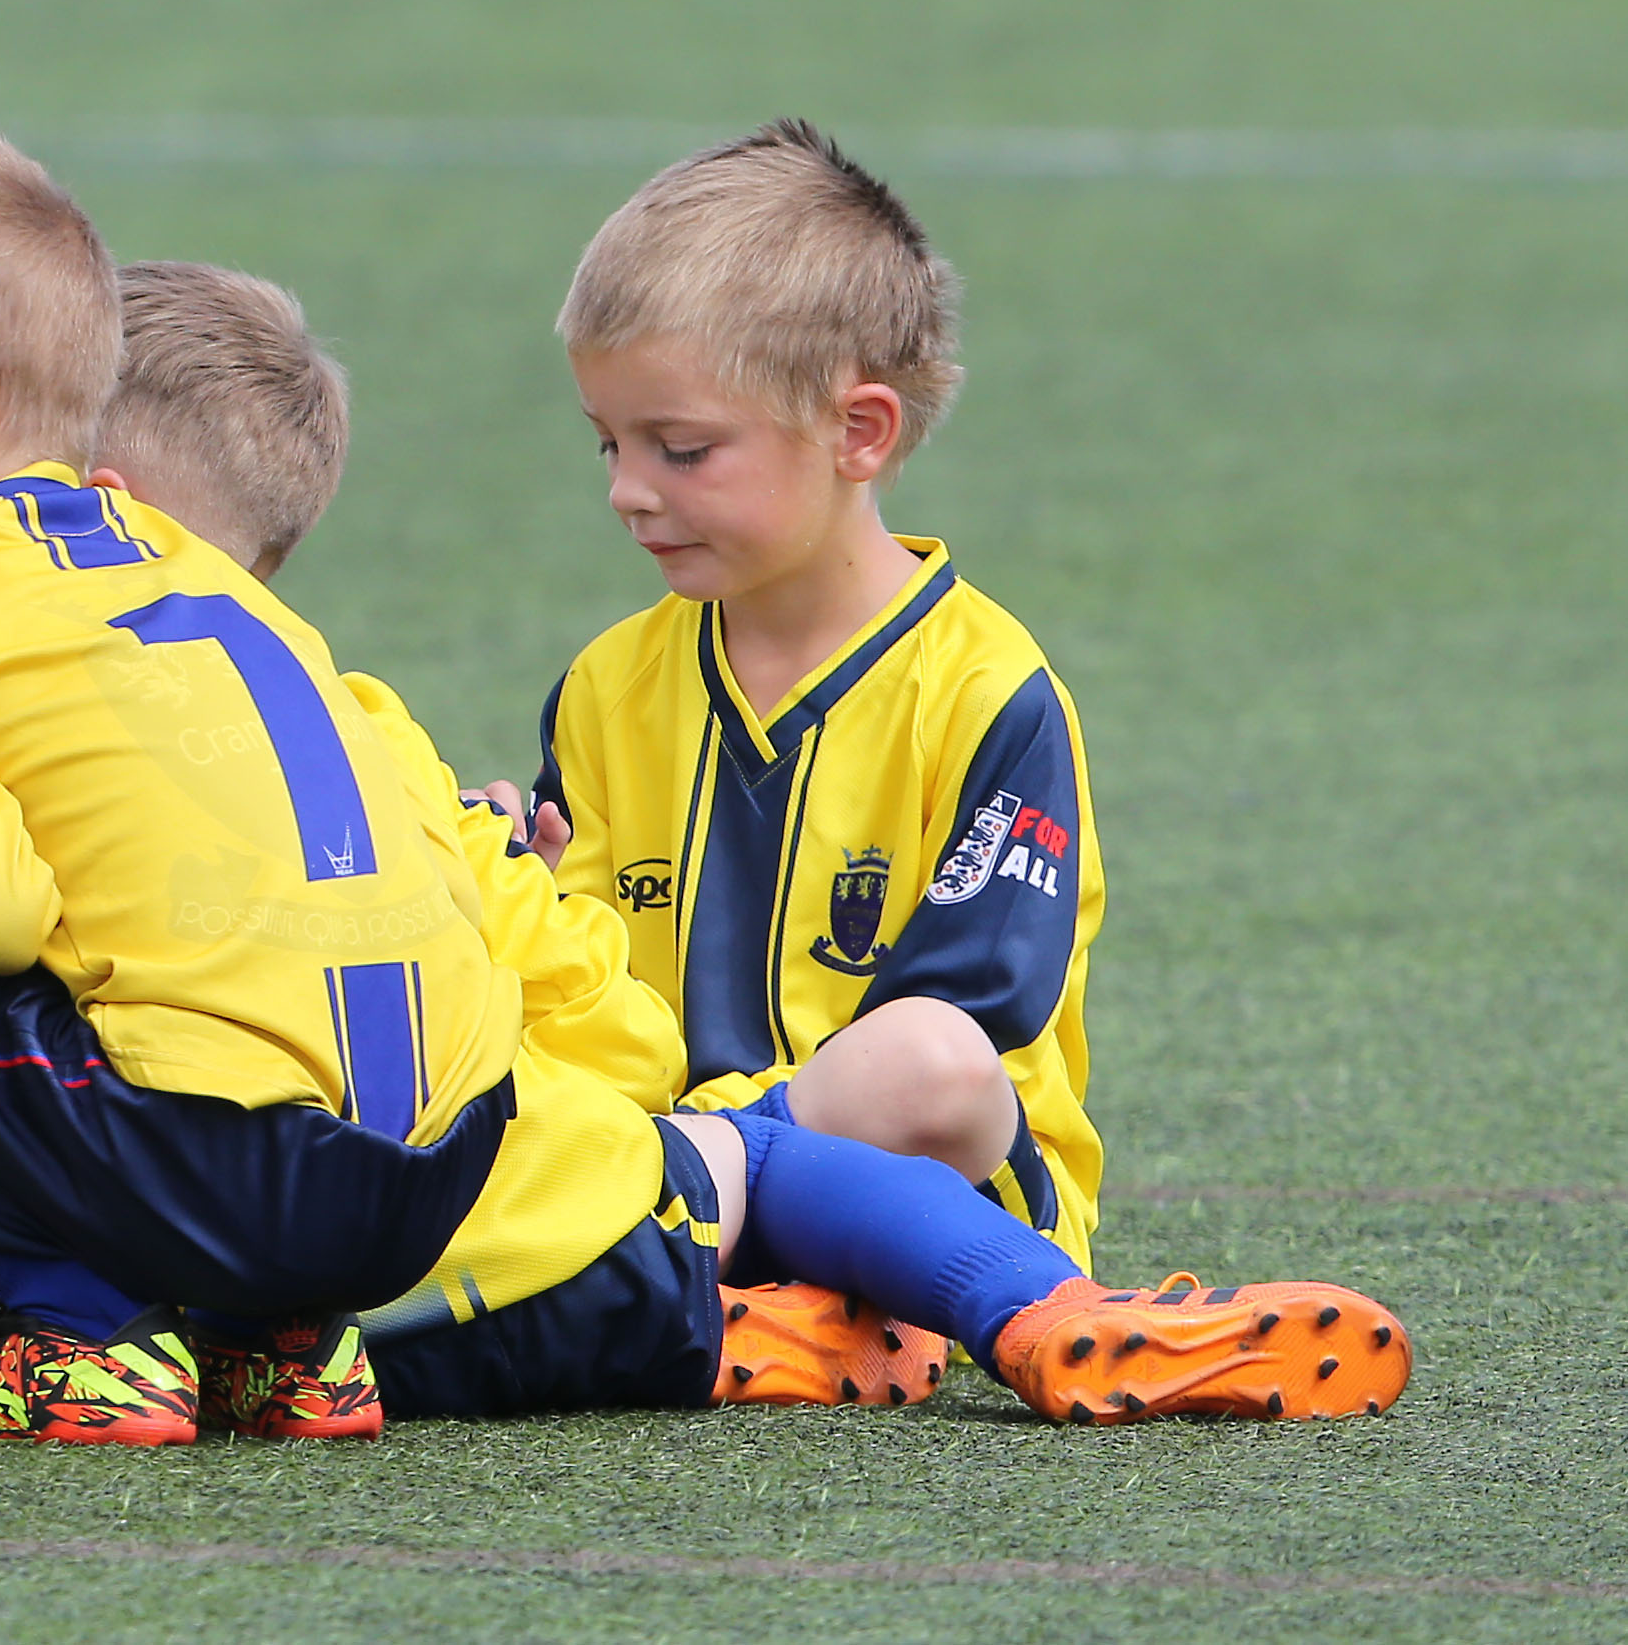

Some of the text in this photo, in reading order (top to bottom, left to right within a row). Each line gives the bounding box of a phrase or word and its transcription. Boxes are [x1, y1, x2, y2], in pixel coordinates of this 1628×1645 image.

[106, 592, 379, 883] 7
[1010, 806, 1070, 859] FOR
[997, 844, 1060, 898] ALL
